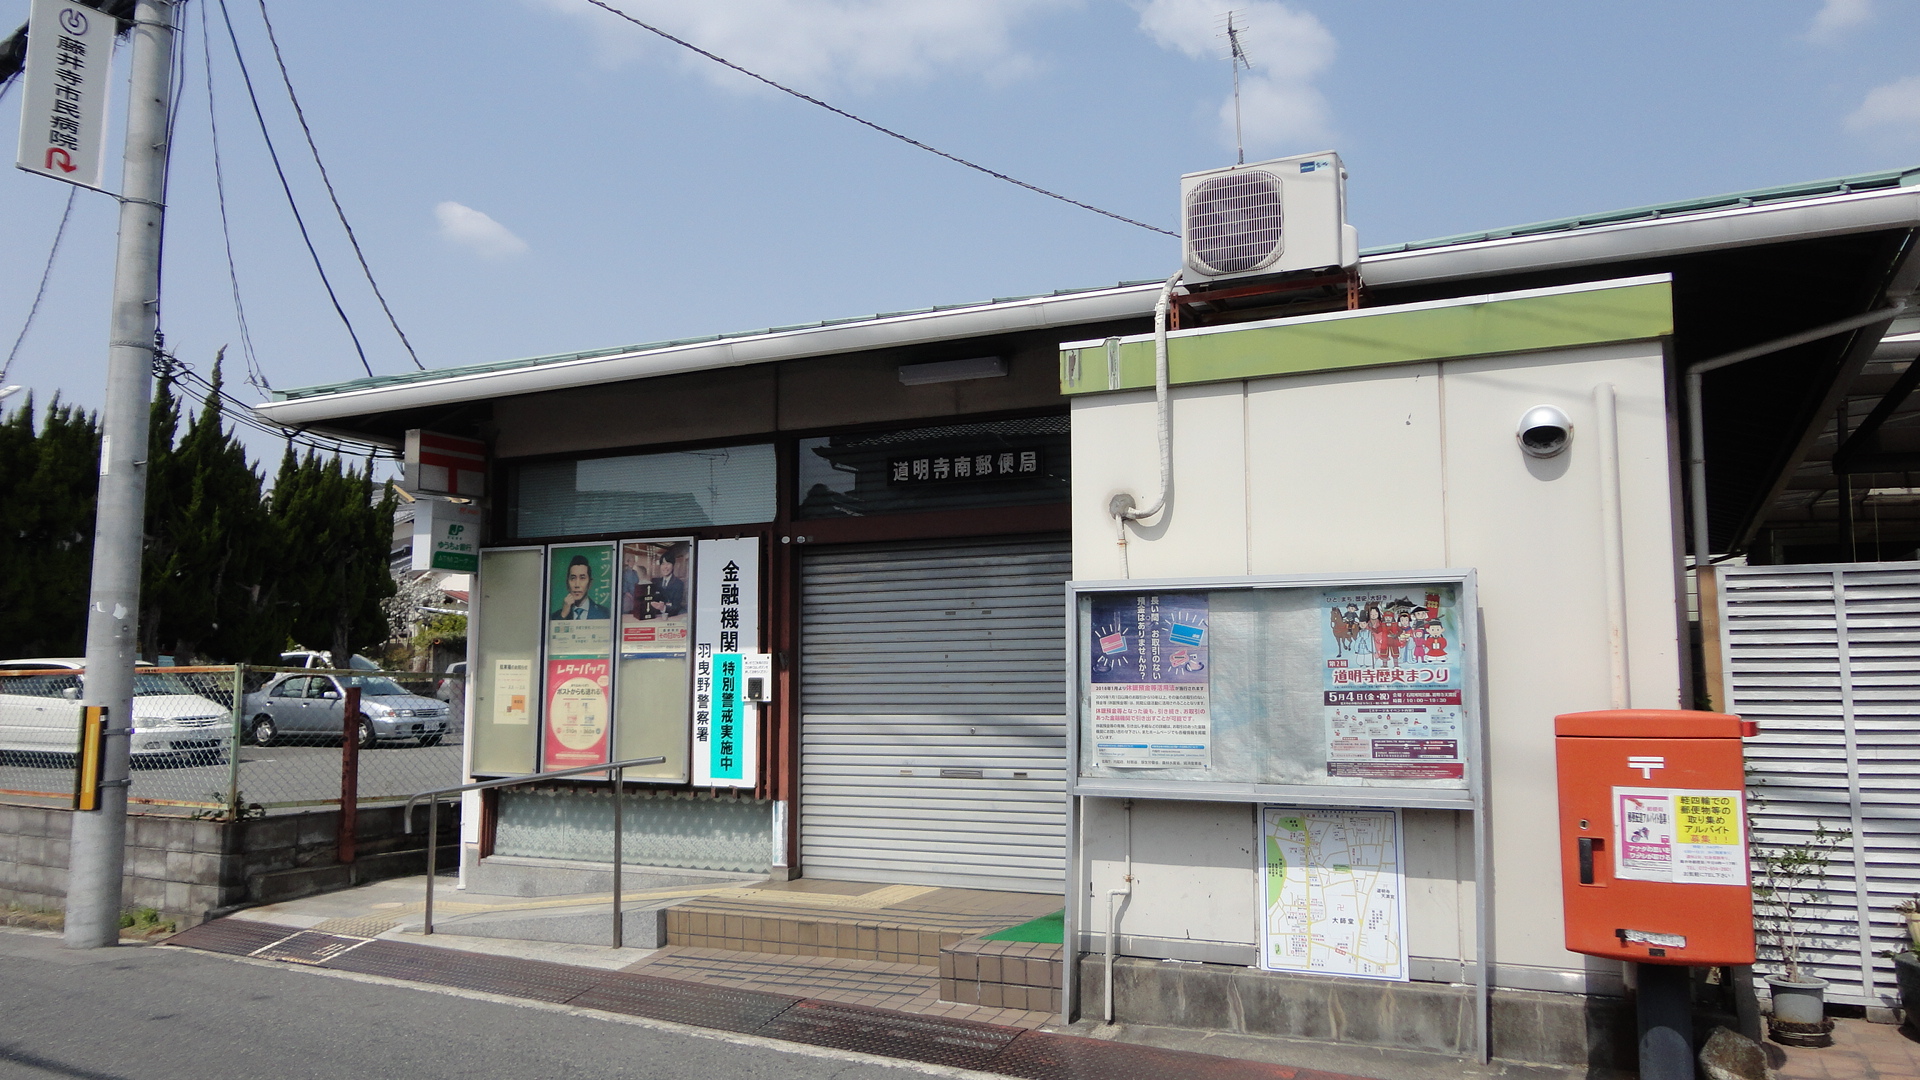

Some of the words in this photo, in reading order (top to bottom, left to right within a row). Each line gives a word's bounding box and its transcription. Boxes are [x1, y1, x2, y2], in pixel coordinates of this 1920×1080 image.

[49, 34, 88, 152] 藤井寺市民病院
[893, 451, 1037, 481] 道明寺南郵便局
[437, 541, 472, 552] ゆうちょ銀行
[600, 551, 611, 605] コツコツ
[720, 560, 740, 653] 金融機関
[1137, 596, 1147, 680] 預金はありませんか？
[1150, 596, 1161, 680] 長い間、お取引のない
[557, 663, 607, 675] レターパック
[1333, 669, 1449, 684] 道明寺歴史まつり
[696, 643, 711, 742] 羽曳野警察署
[720, 661, 735, 771] 特別警戒実施中
[1681, 796, 1730, 805] 軽四輪での
[1681, 806, 1731, 815] 郵便物等の
[1684, 825, 1730, 834] アルバイト
[1687, 815, 1726, 824] 取り集め
[1332, 917, 1355, 925] 大師堂
